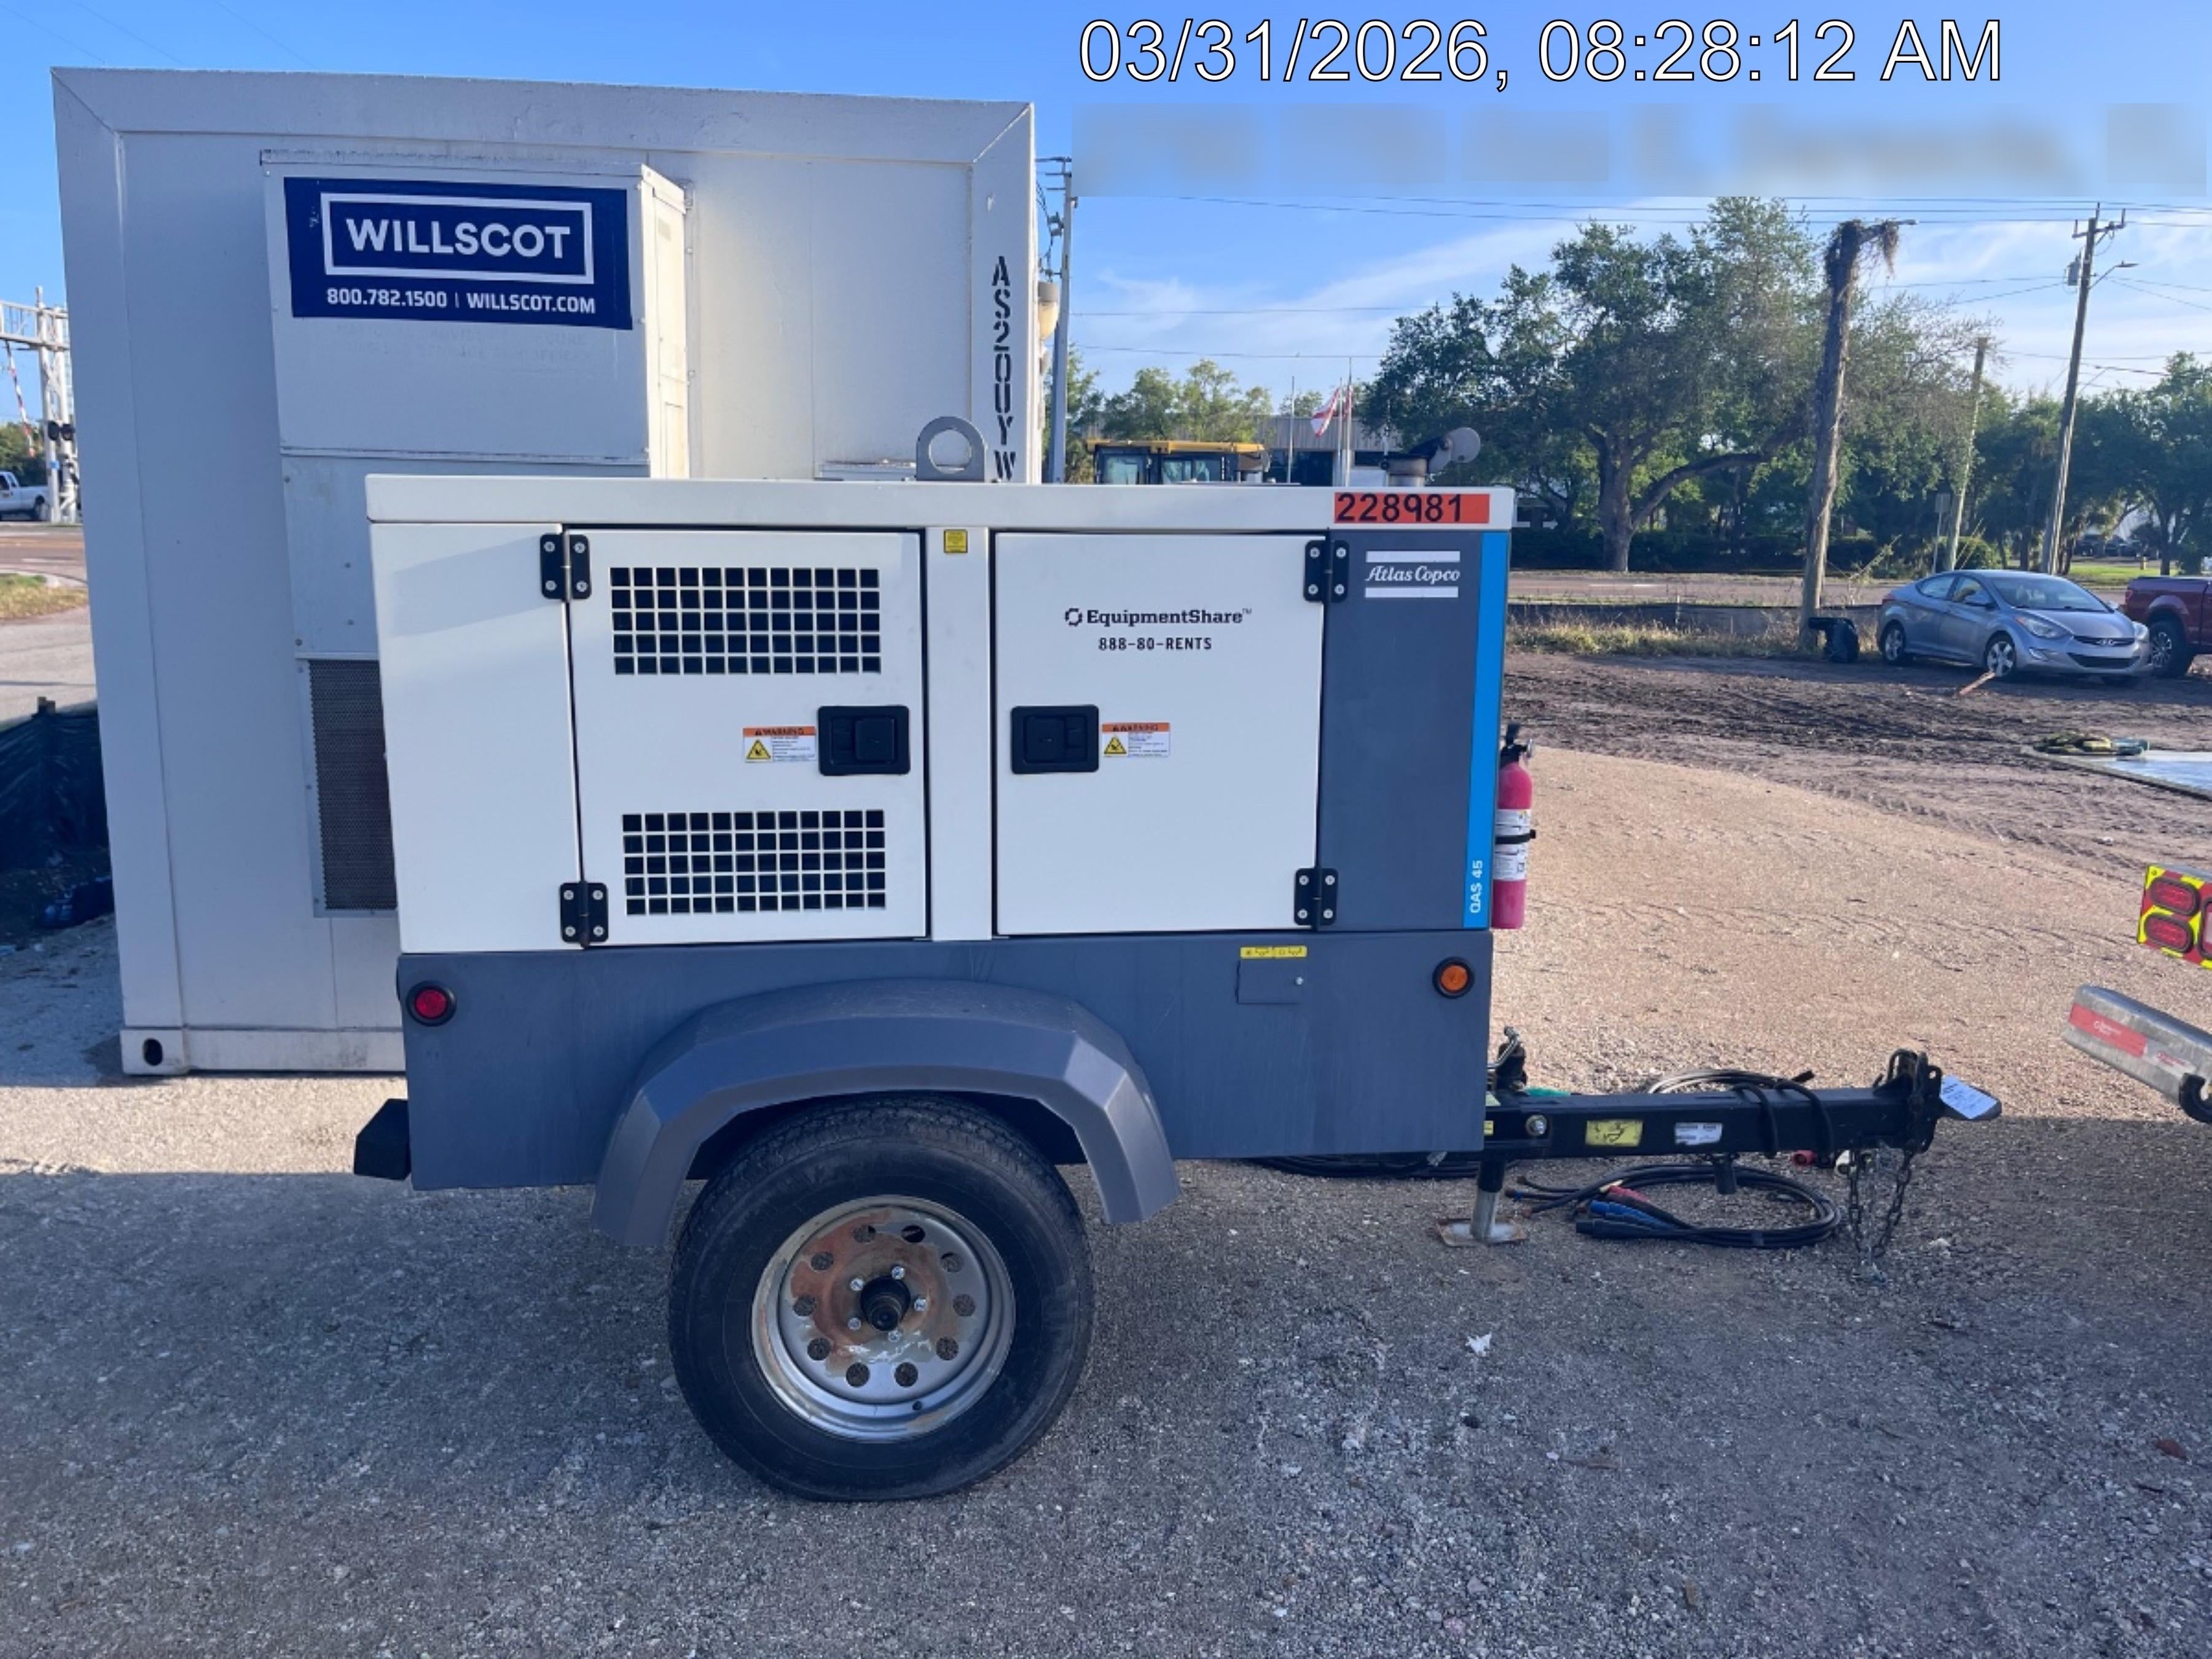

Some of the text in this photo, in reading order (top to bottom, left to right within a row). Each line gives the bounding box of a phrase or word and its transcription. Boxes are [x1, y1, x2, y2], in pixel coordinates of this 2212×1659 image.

[345, 218, 571, 259] WILLSCOT
[326, 288, 596, 315] 800.782.1500 WILLSCOT.COM
[1336, 492, 1462, 523] 228981
[1365, 565, 1461, 585] Atlas Copco
[1098, 637, 1212, 651] 888-80-RENTS
[1470, 860, 1483, 914] QAS 45
